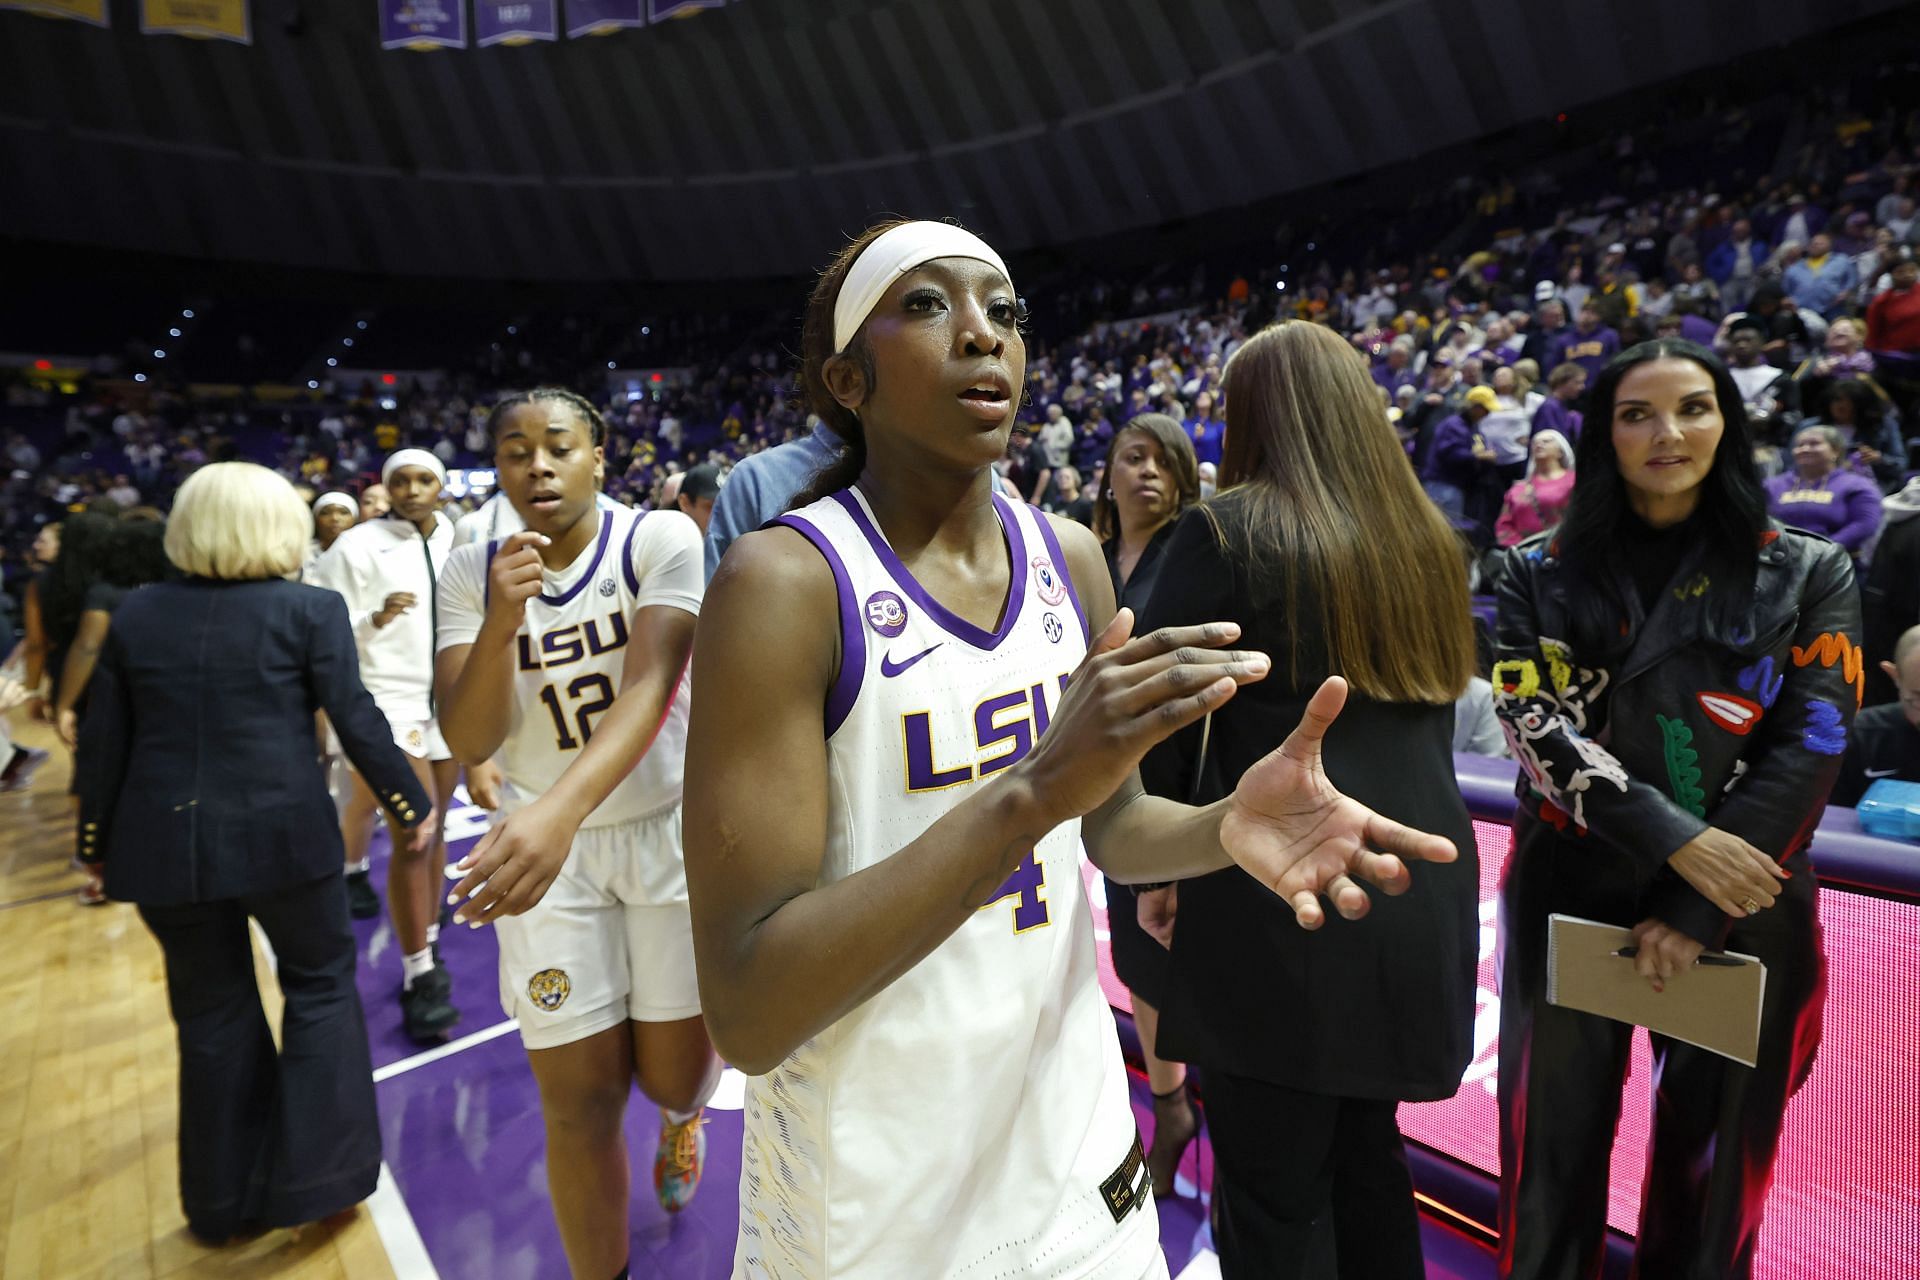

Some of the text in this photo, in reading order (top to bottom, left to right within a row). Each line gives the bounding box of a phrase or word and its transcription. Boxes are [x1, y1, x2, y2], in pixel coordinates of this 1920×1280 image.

[516, 610, 630, 672] LSU
[867, 599, 901, 626] 50
[539, 672, 615, 752] 12
